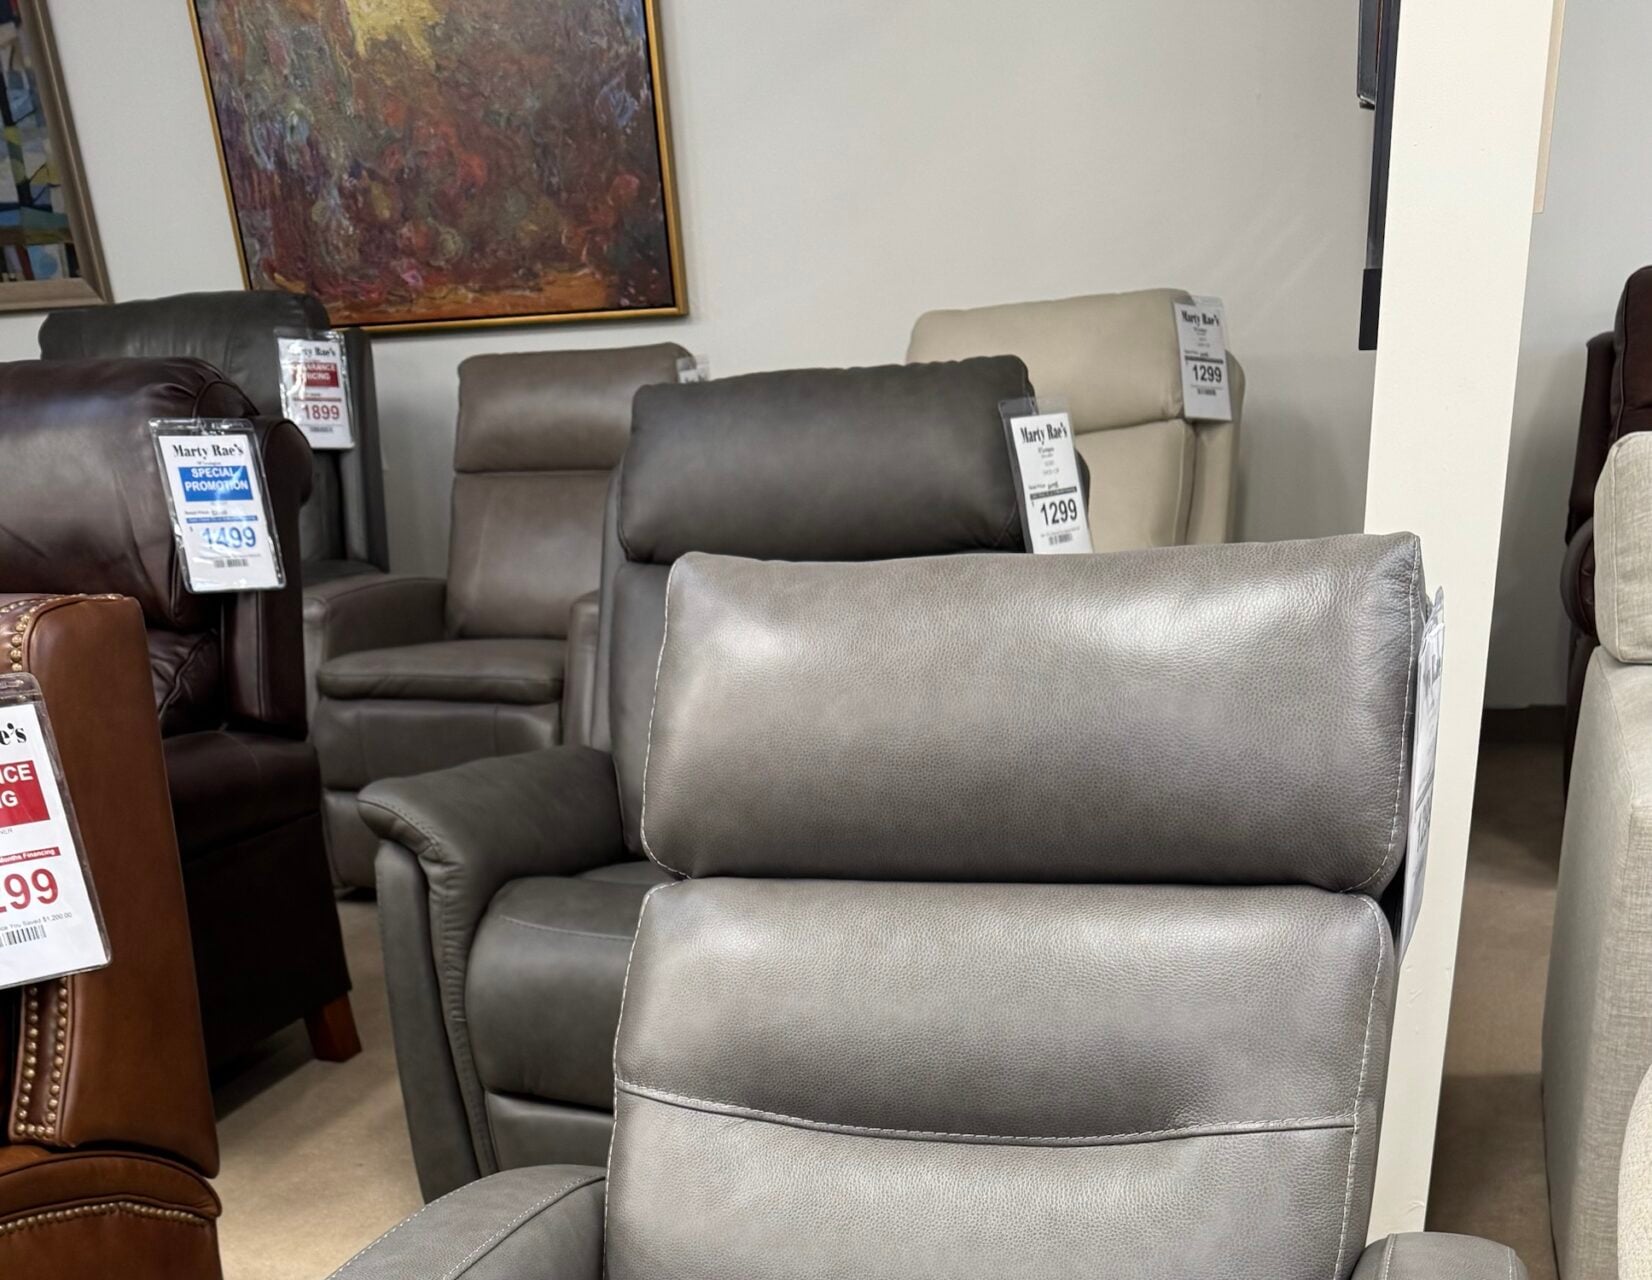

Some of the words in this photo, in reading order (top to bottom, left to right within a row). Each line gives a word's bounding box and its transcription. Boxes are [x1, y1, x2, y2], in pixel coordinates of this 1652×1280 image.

[1181, 309, 1200, 327] Marty
[1201, 312, 1220, 326] Rae's
[1192, 364, 1223, 383] 1299
[303, 404, 340, 420] 1899
[1020, 427, 1045, 446] Marty
[1046, 421, 1068, 441] Rae's
[172, 444, 207, 460] Marty
[211, 443, 245, 457] Rae's
[190, 467, 235, 479] SPECIAL
[184, 480, 248, 492] PROMOTION
[1040, 498, 1077, 526] 1299
[203, 526, 256, 549] 1499
